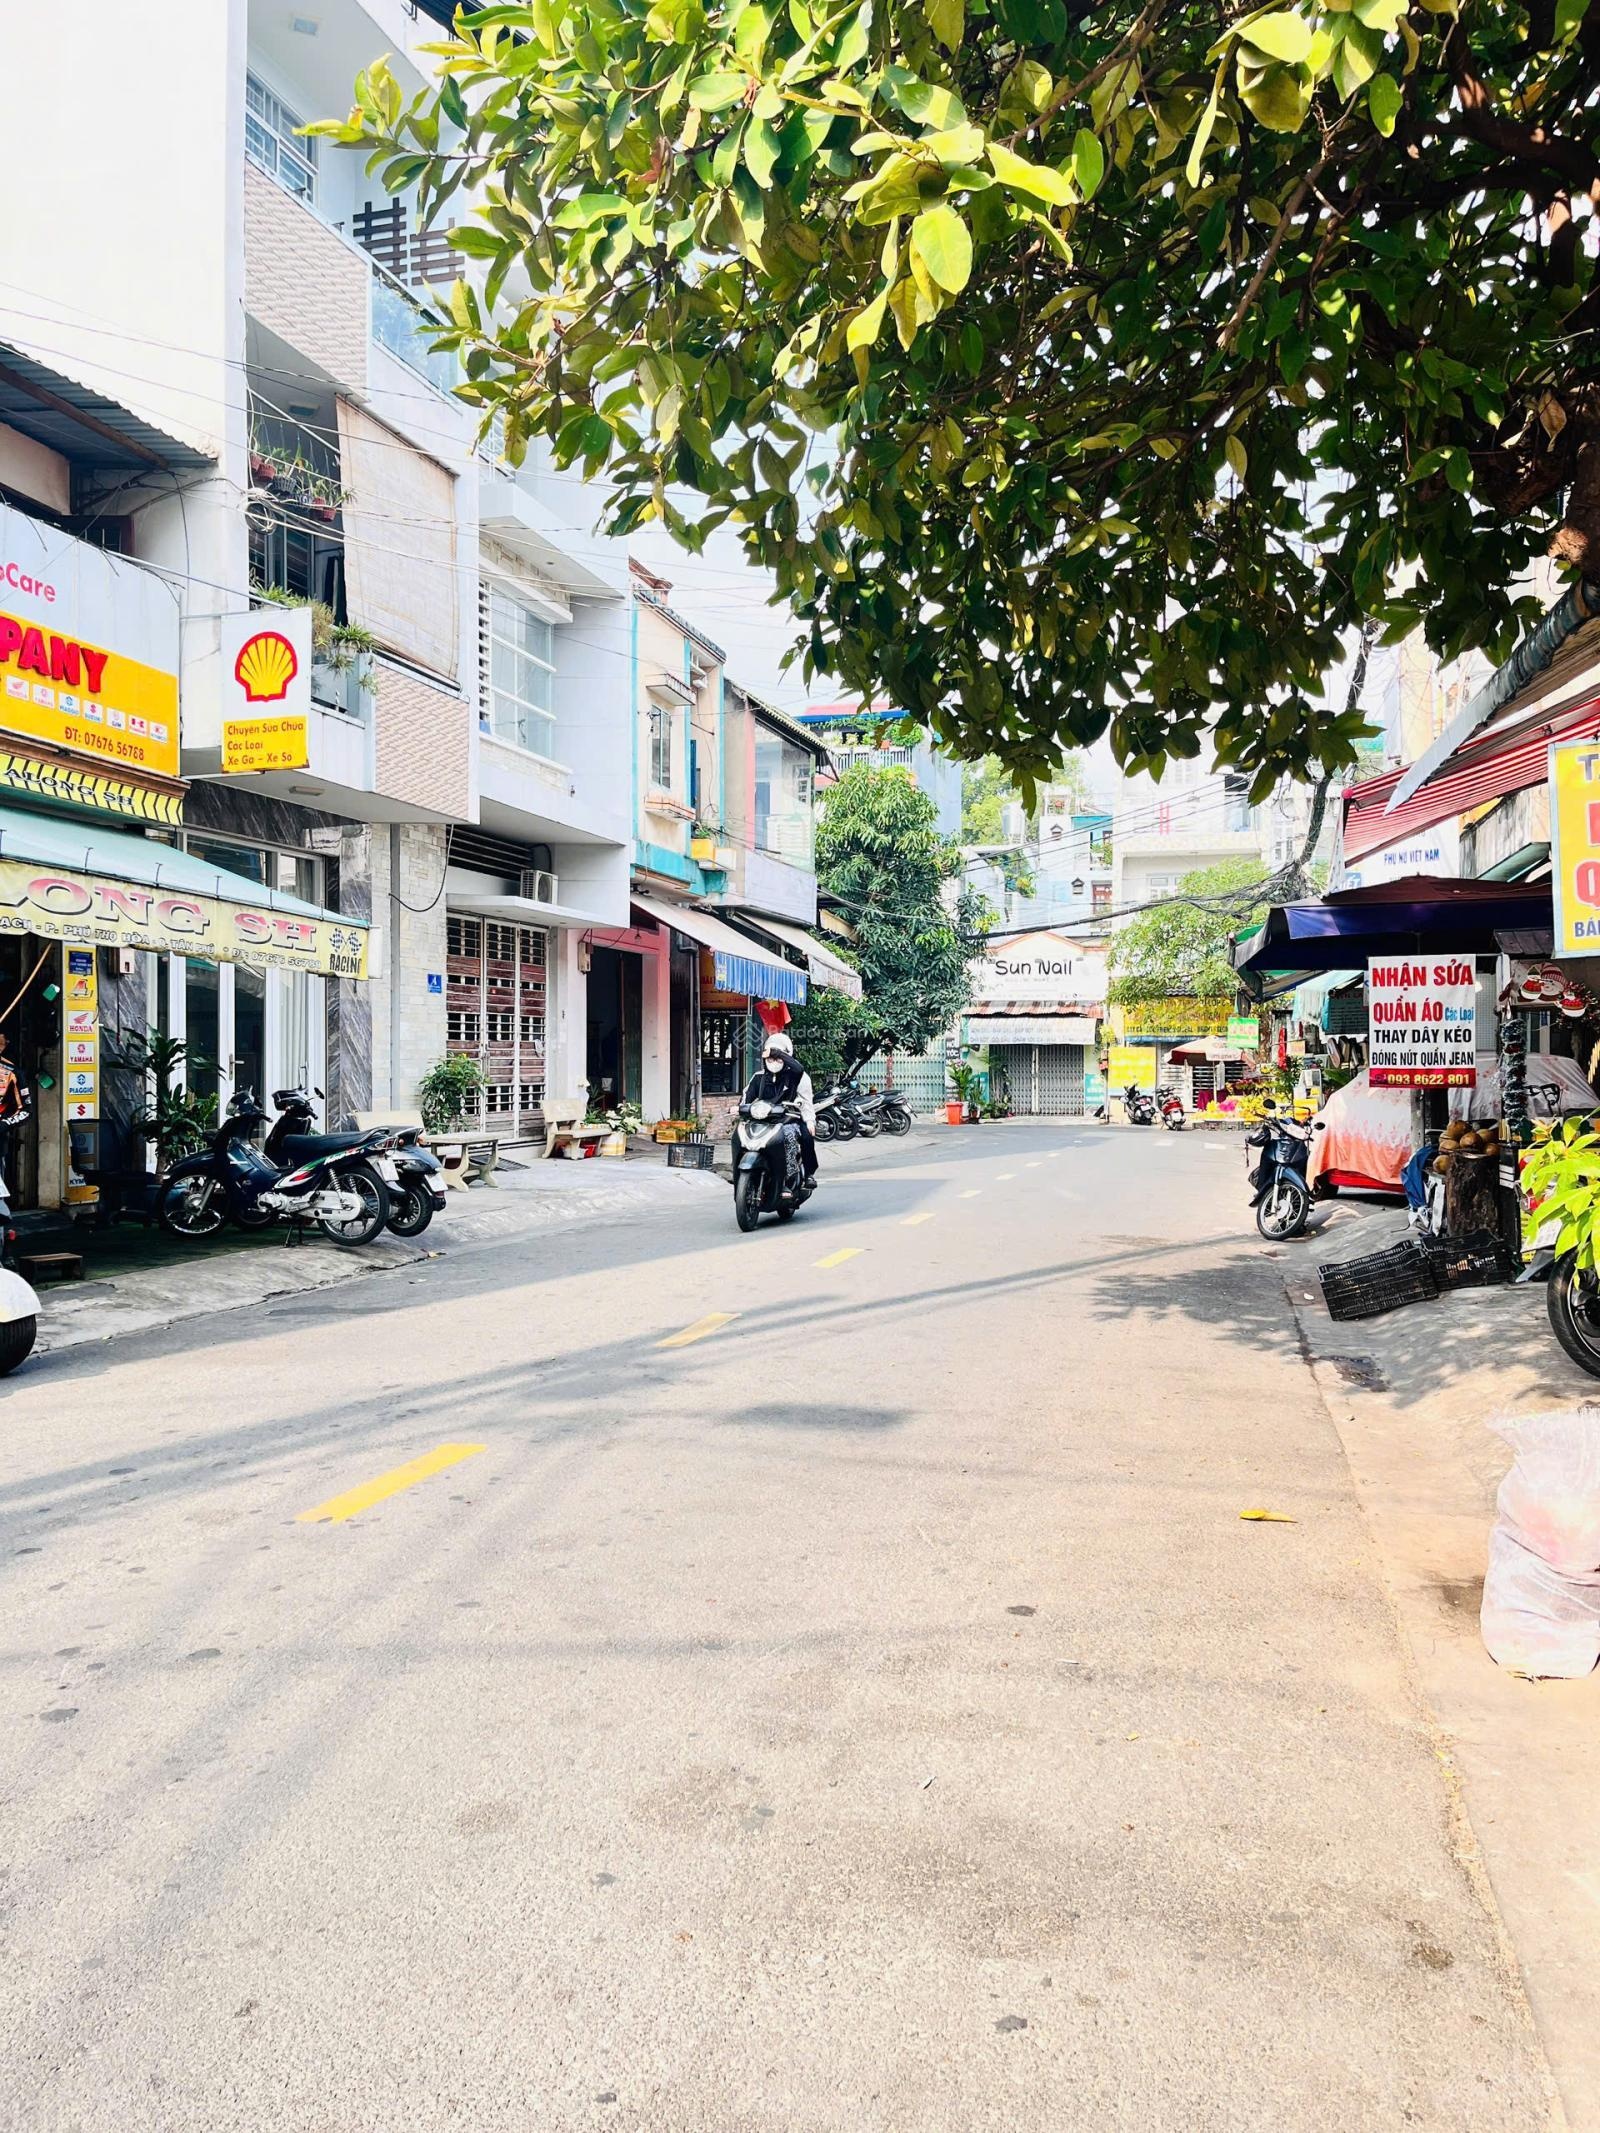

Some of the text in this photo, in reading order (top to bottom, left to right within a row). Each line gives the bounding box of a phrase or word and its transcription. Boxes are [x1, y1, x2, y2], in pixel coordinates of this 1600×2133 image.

[84, 732, 114, 752] 07676
[242, 754, 255, 765] Ga
[5, 768, 133, 807] ALONG SH
[1425, 848, 1440, 861] NAM
[45, 922, 59, 934] P.
[234, 912, 317, 953] SH
[995, 960, 1072, 975] Sun Nail
[1372, 959, 1474, 991] NHẬN SỬA
[1421, 998, 1444, 1022] ÁO
[1459, 1006, 1474, 1024] Loại
[1374, 1025, 1472, 1044] THAY DÂY KÉO
[1372, 1049, 1397, 1066] ĐÓNG
[1400, 1049, 1418, 1066] NÚT
[1449, 1051, 1474, 1065] JEAN
[1387, 1073, 1470, 1085] 093 8622 801
